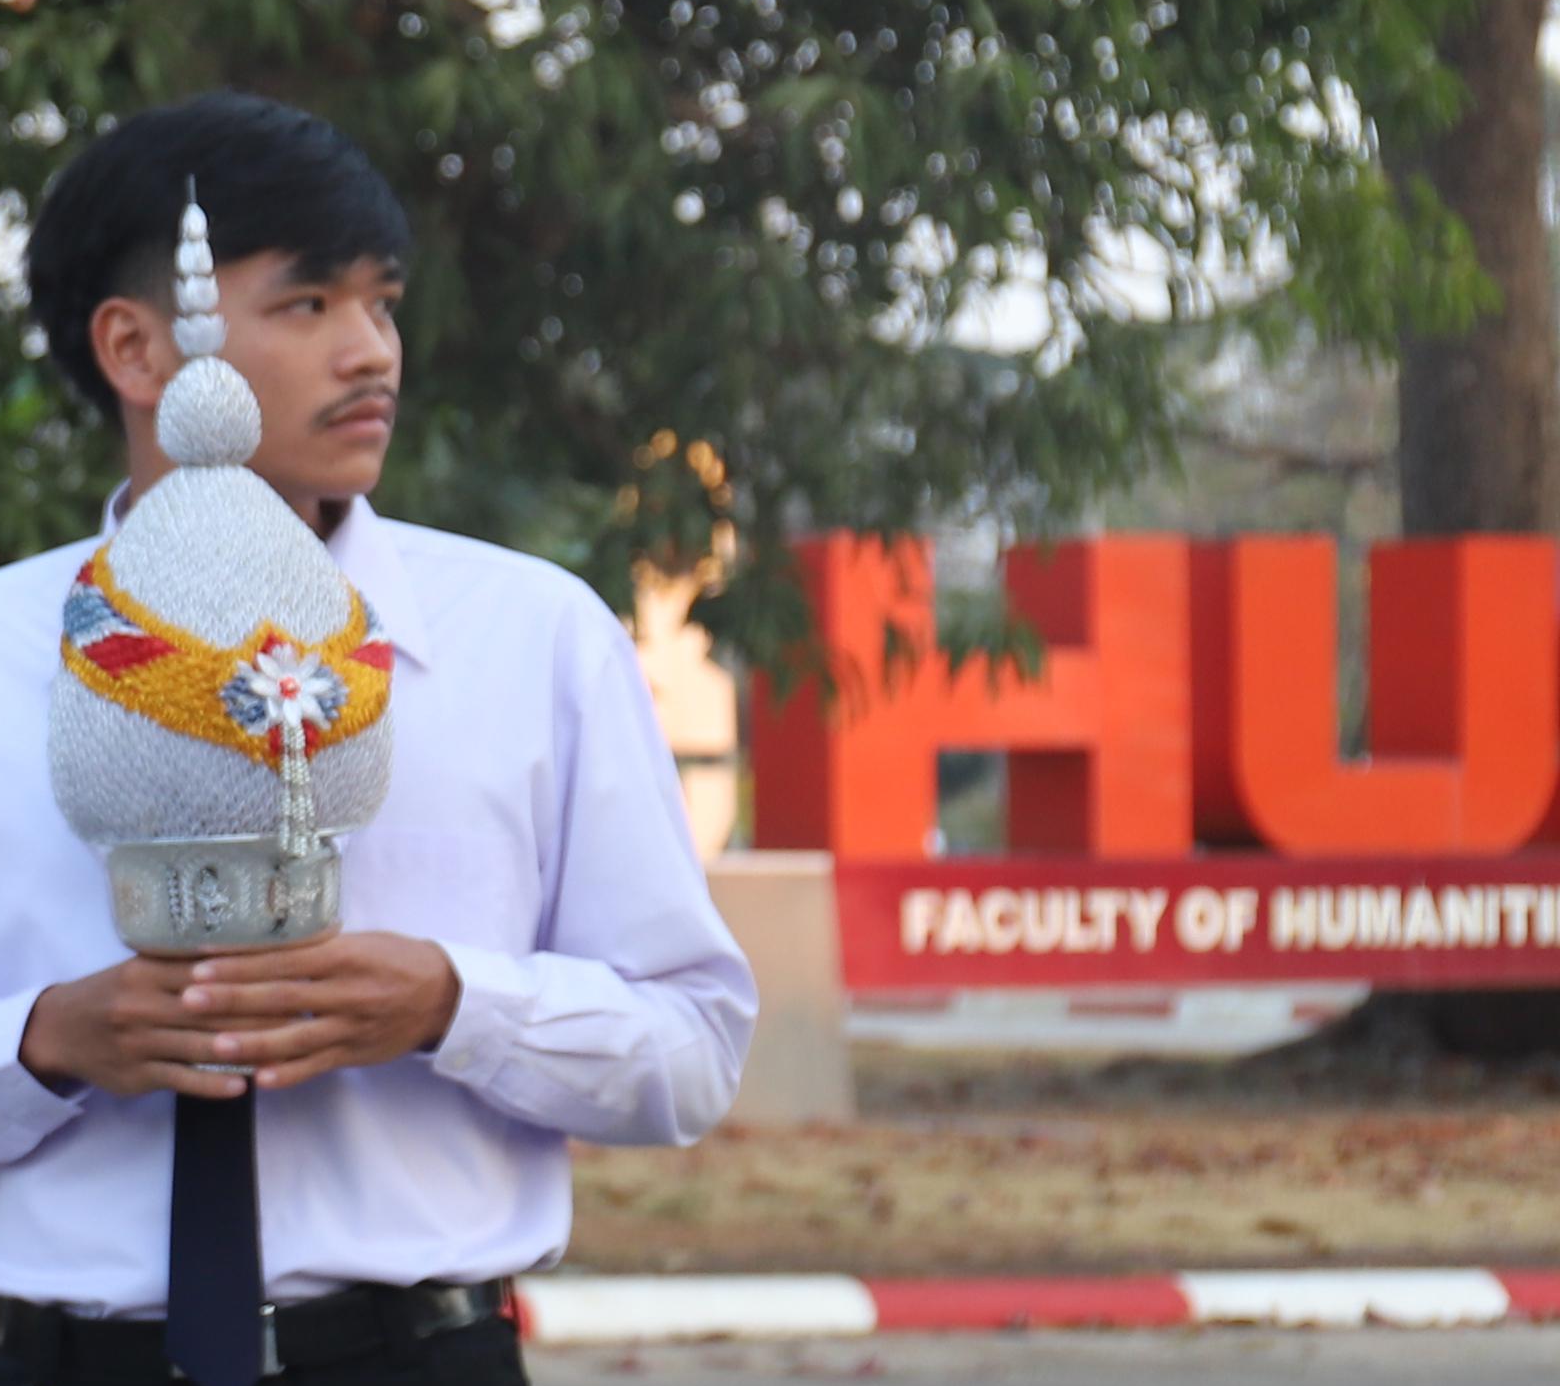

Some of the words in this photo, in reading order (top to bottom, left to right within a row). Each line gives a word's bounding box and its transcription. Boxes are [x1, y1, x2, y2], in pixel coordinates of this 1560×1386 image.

[828, 529, 1558, 859] HU
[900, 885, 1170, 955] FACULTY
[1173, 885, 1260, 954] OF
[1269, 883, 1560, 952] HUMANITI
